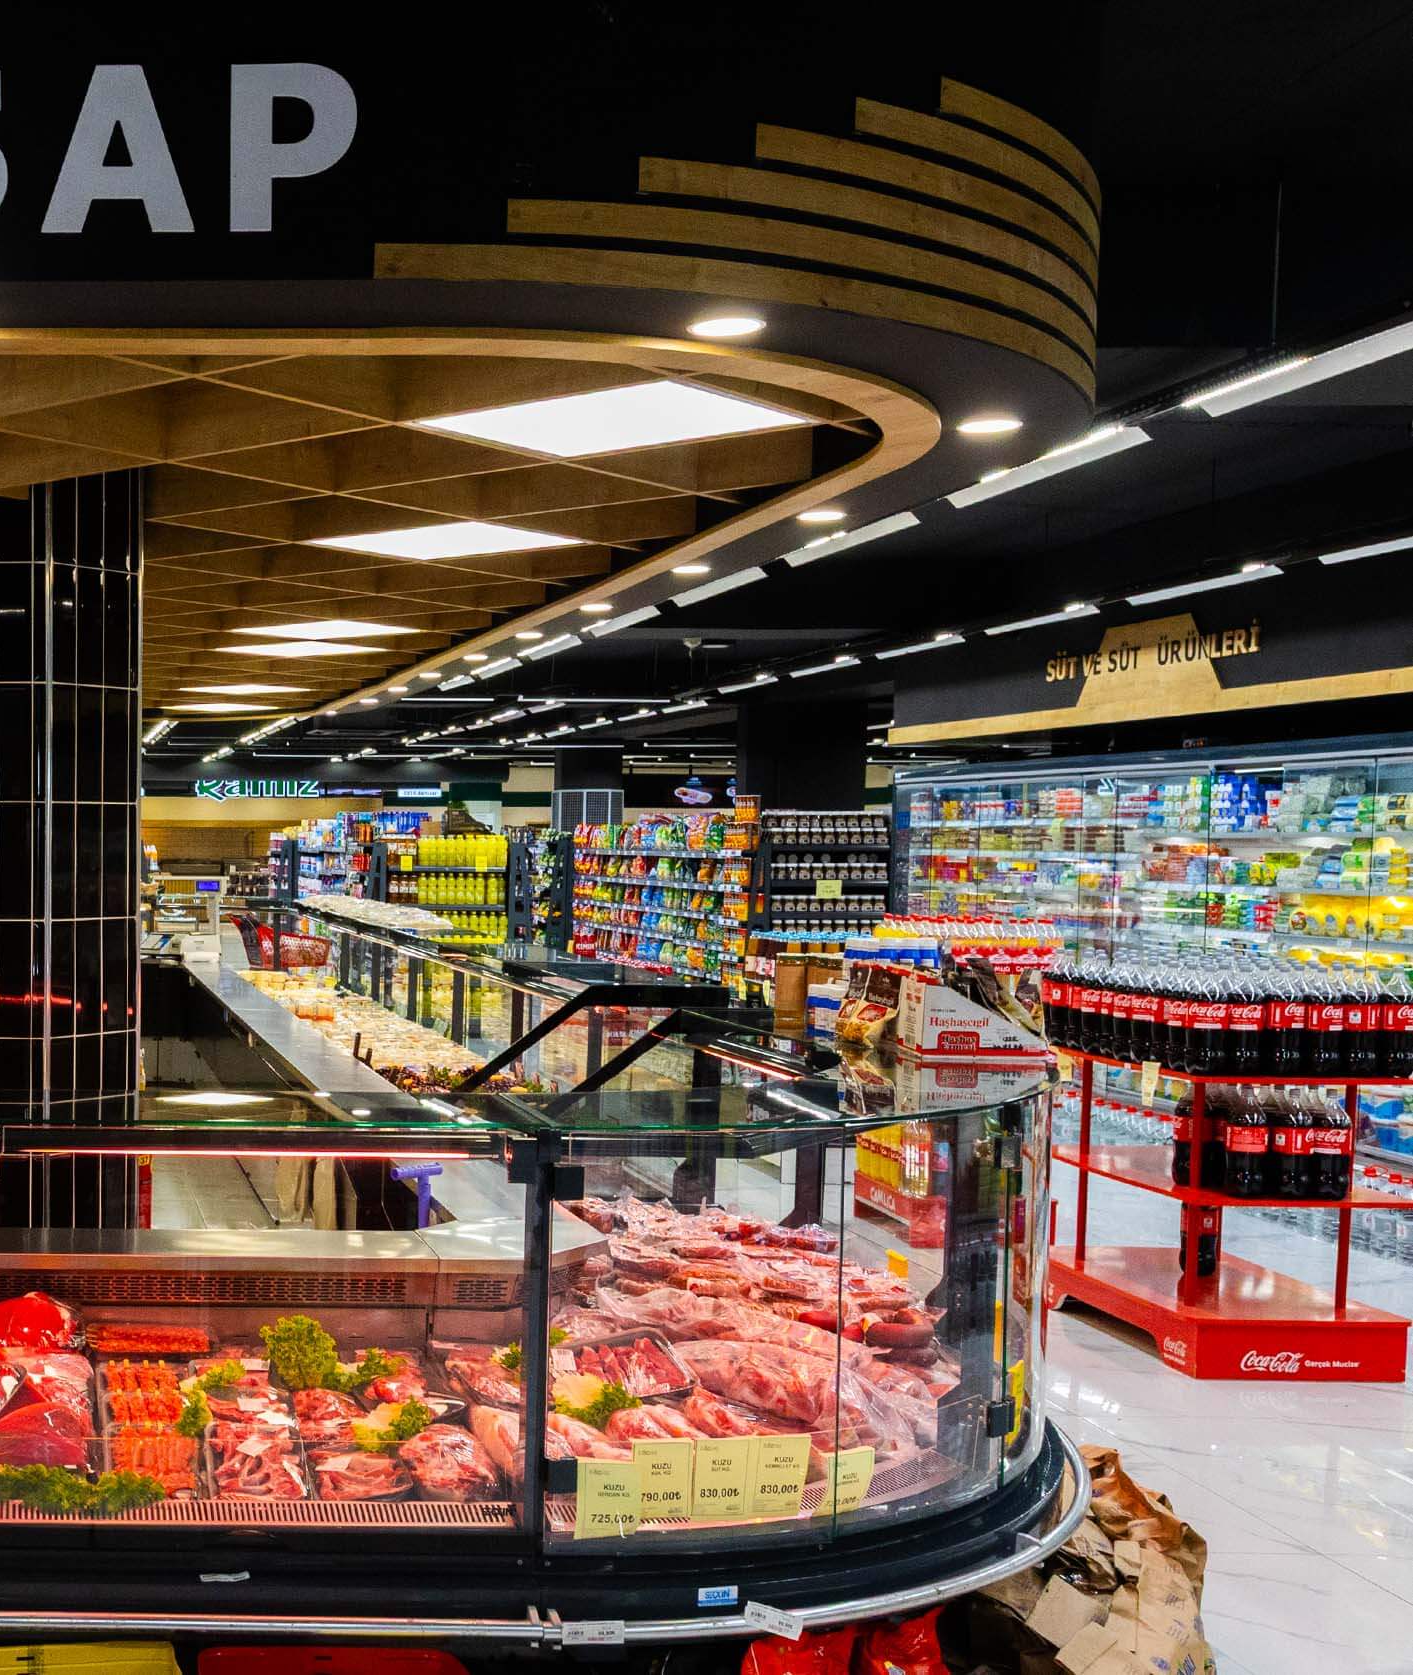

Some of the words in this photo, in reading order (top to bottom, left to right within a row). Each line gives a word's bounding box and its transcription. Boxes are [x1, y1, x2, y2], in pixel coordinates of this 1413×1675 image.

[1045, 651, 1077, 682] SÜT
[1082, 652, 1102, 676] VE
[1107, 640, 1141, 673] SÜT
[1157, 618, 1262, 665] ÜRÜNLERİ
[771, 1456, 795, 1464] KUZU
